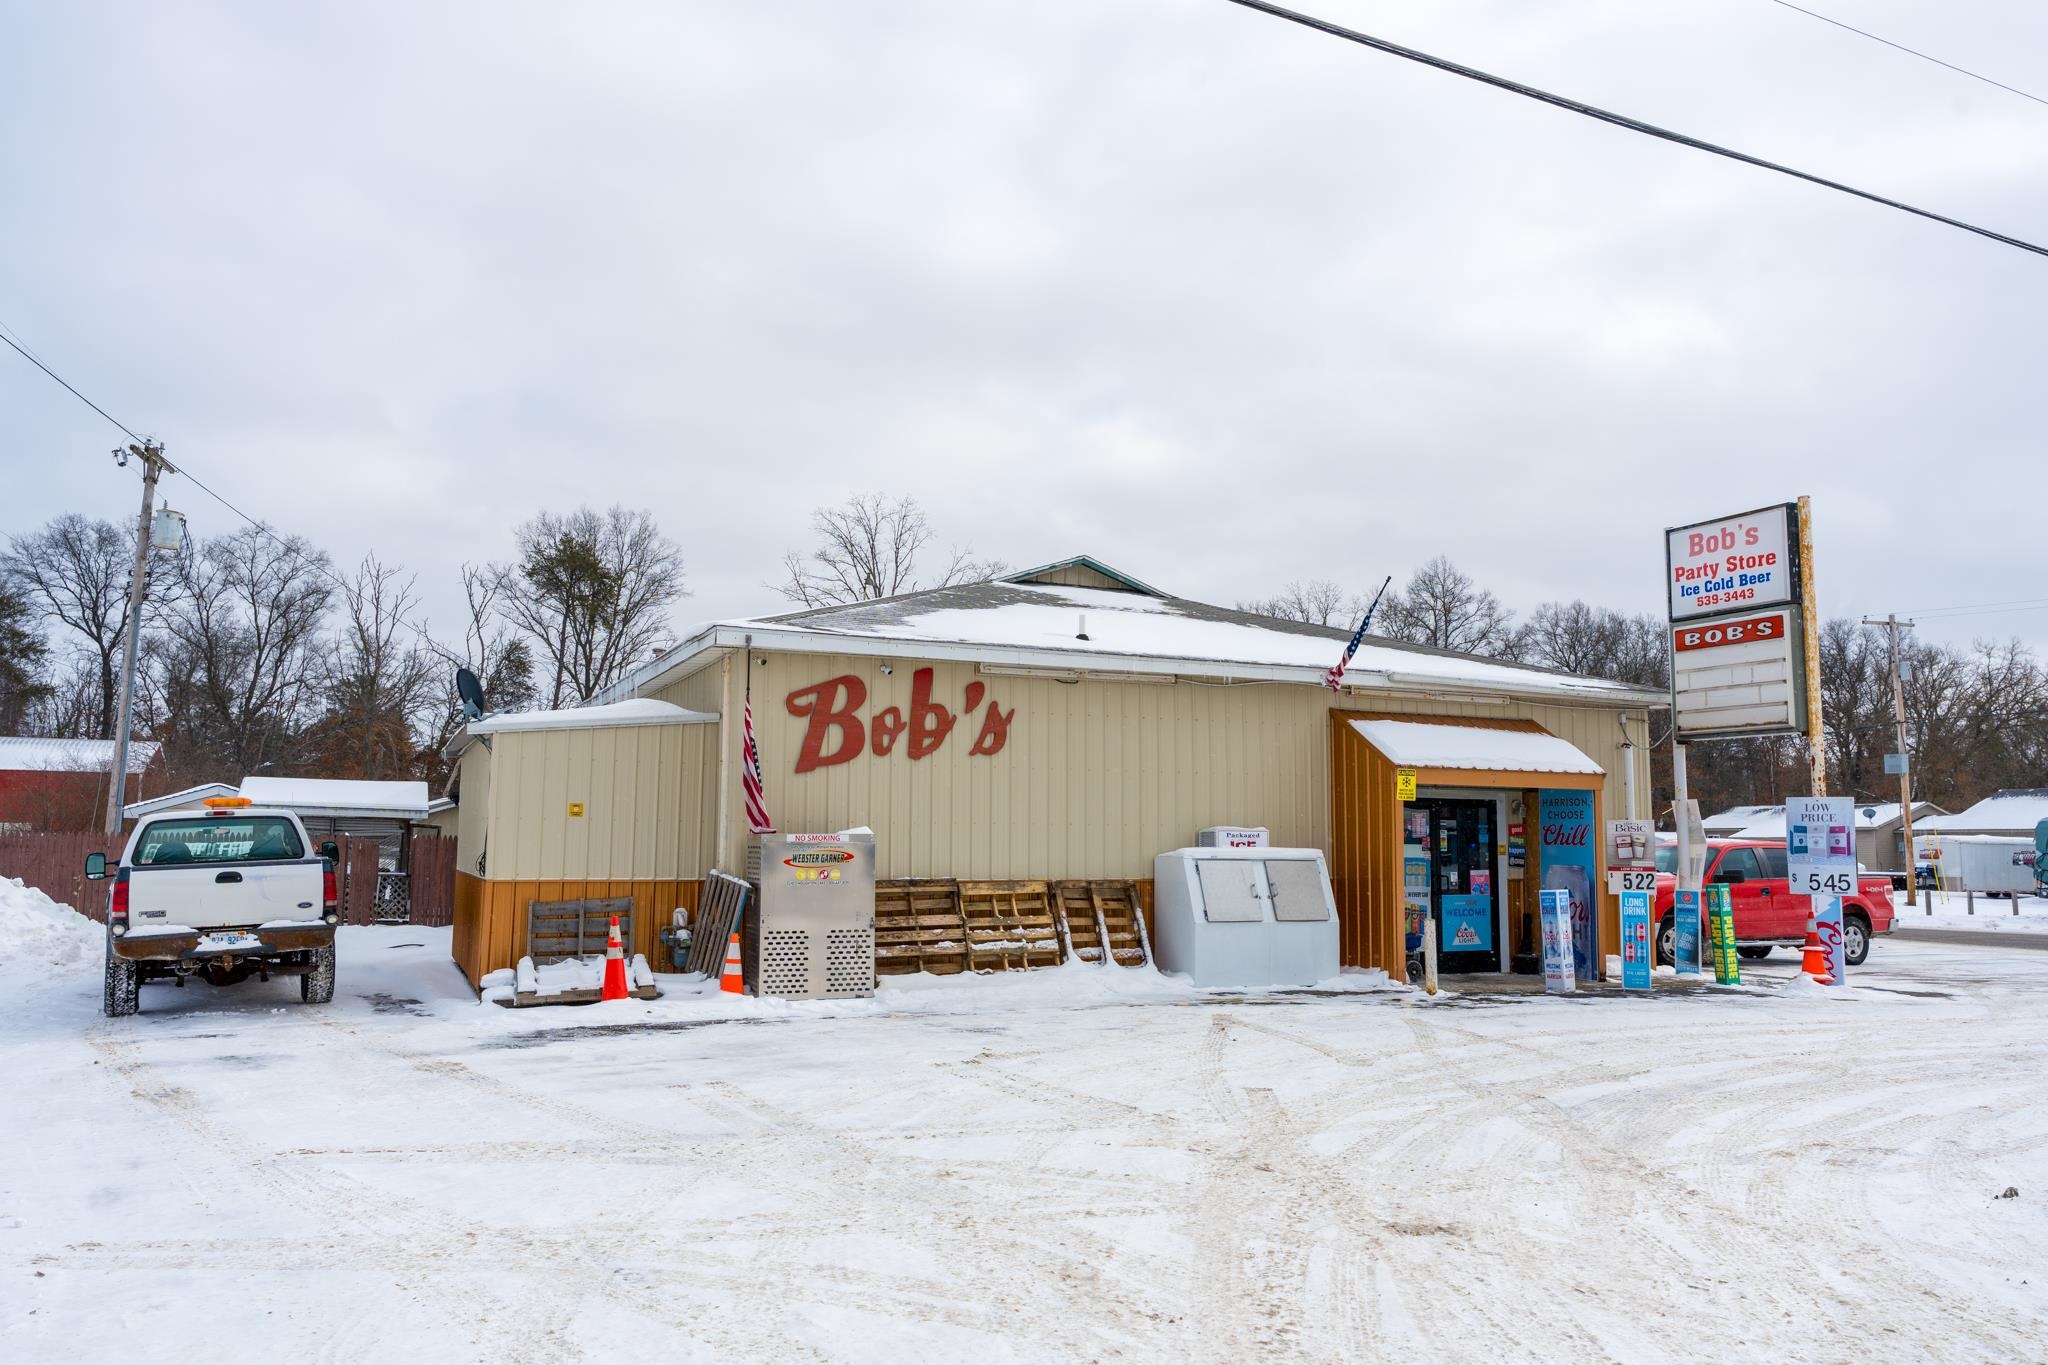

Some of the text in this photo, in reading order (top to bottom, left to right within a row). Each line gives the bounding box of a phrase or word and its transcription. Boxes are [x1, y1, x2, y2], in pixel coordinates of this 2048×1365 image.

[1689, 524, 1759, 557] Bob's
[1675, 553, 1776, 582] Party Store
[1681, 572, 1771, 597] Ice Cold Beer
[1697, 588, 1754, 607] 539-3443
[1684, 622, 1773, 646] BOB'S
[786, 667, 1015, 774] Bob's
[1547, 810, 1585, 819] CHOOSE
[1805, 803, 1832, 812] LOW
[1615, 823, 1646, 832] Basic
[1801, 813, 1837, 823] PRICE
[1543, 823, 1590, 846] Chill
[792, 853, 845, 863] WEBSTER GARNER
[1791, 873, 1851, 893] $ 5.45
[1446, 907, 1487, 917] WELCOME
[1623, 906, 1646, 915] DRINK
[1625, 897, 1644, 907] LONG
[1710, 916, 1723, 946] PLAY
[1723, 915, 1739, 979] PLAY HERE
[1714, 948, 1725, 979] HERE
